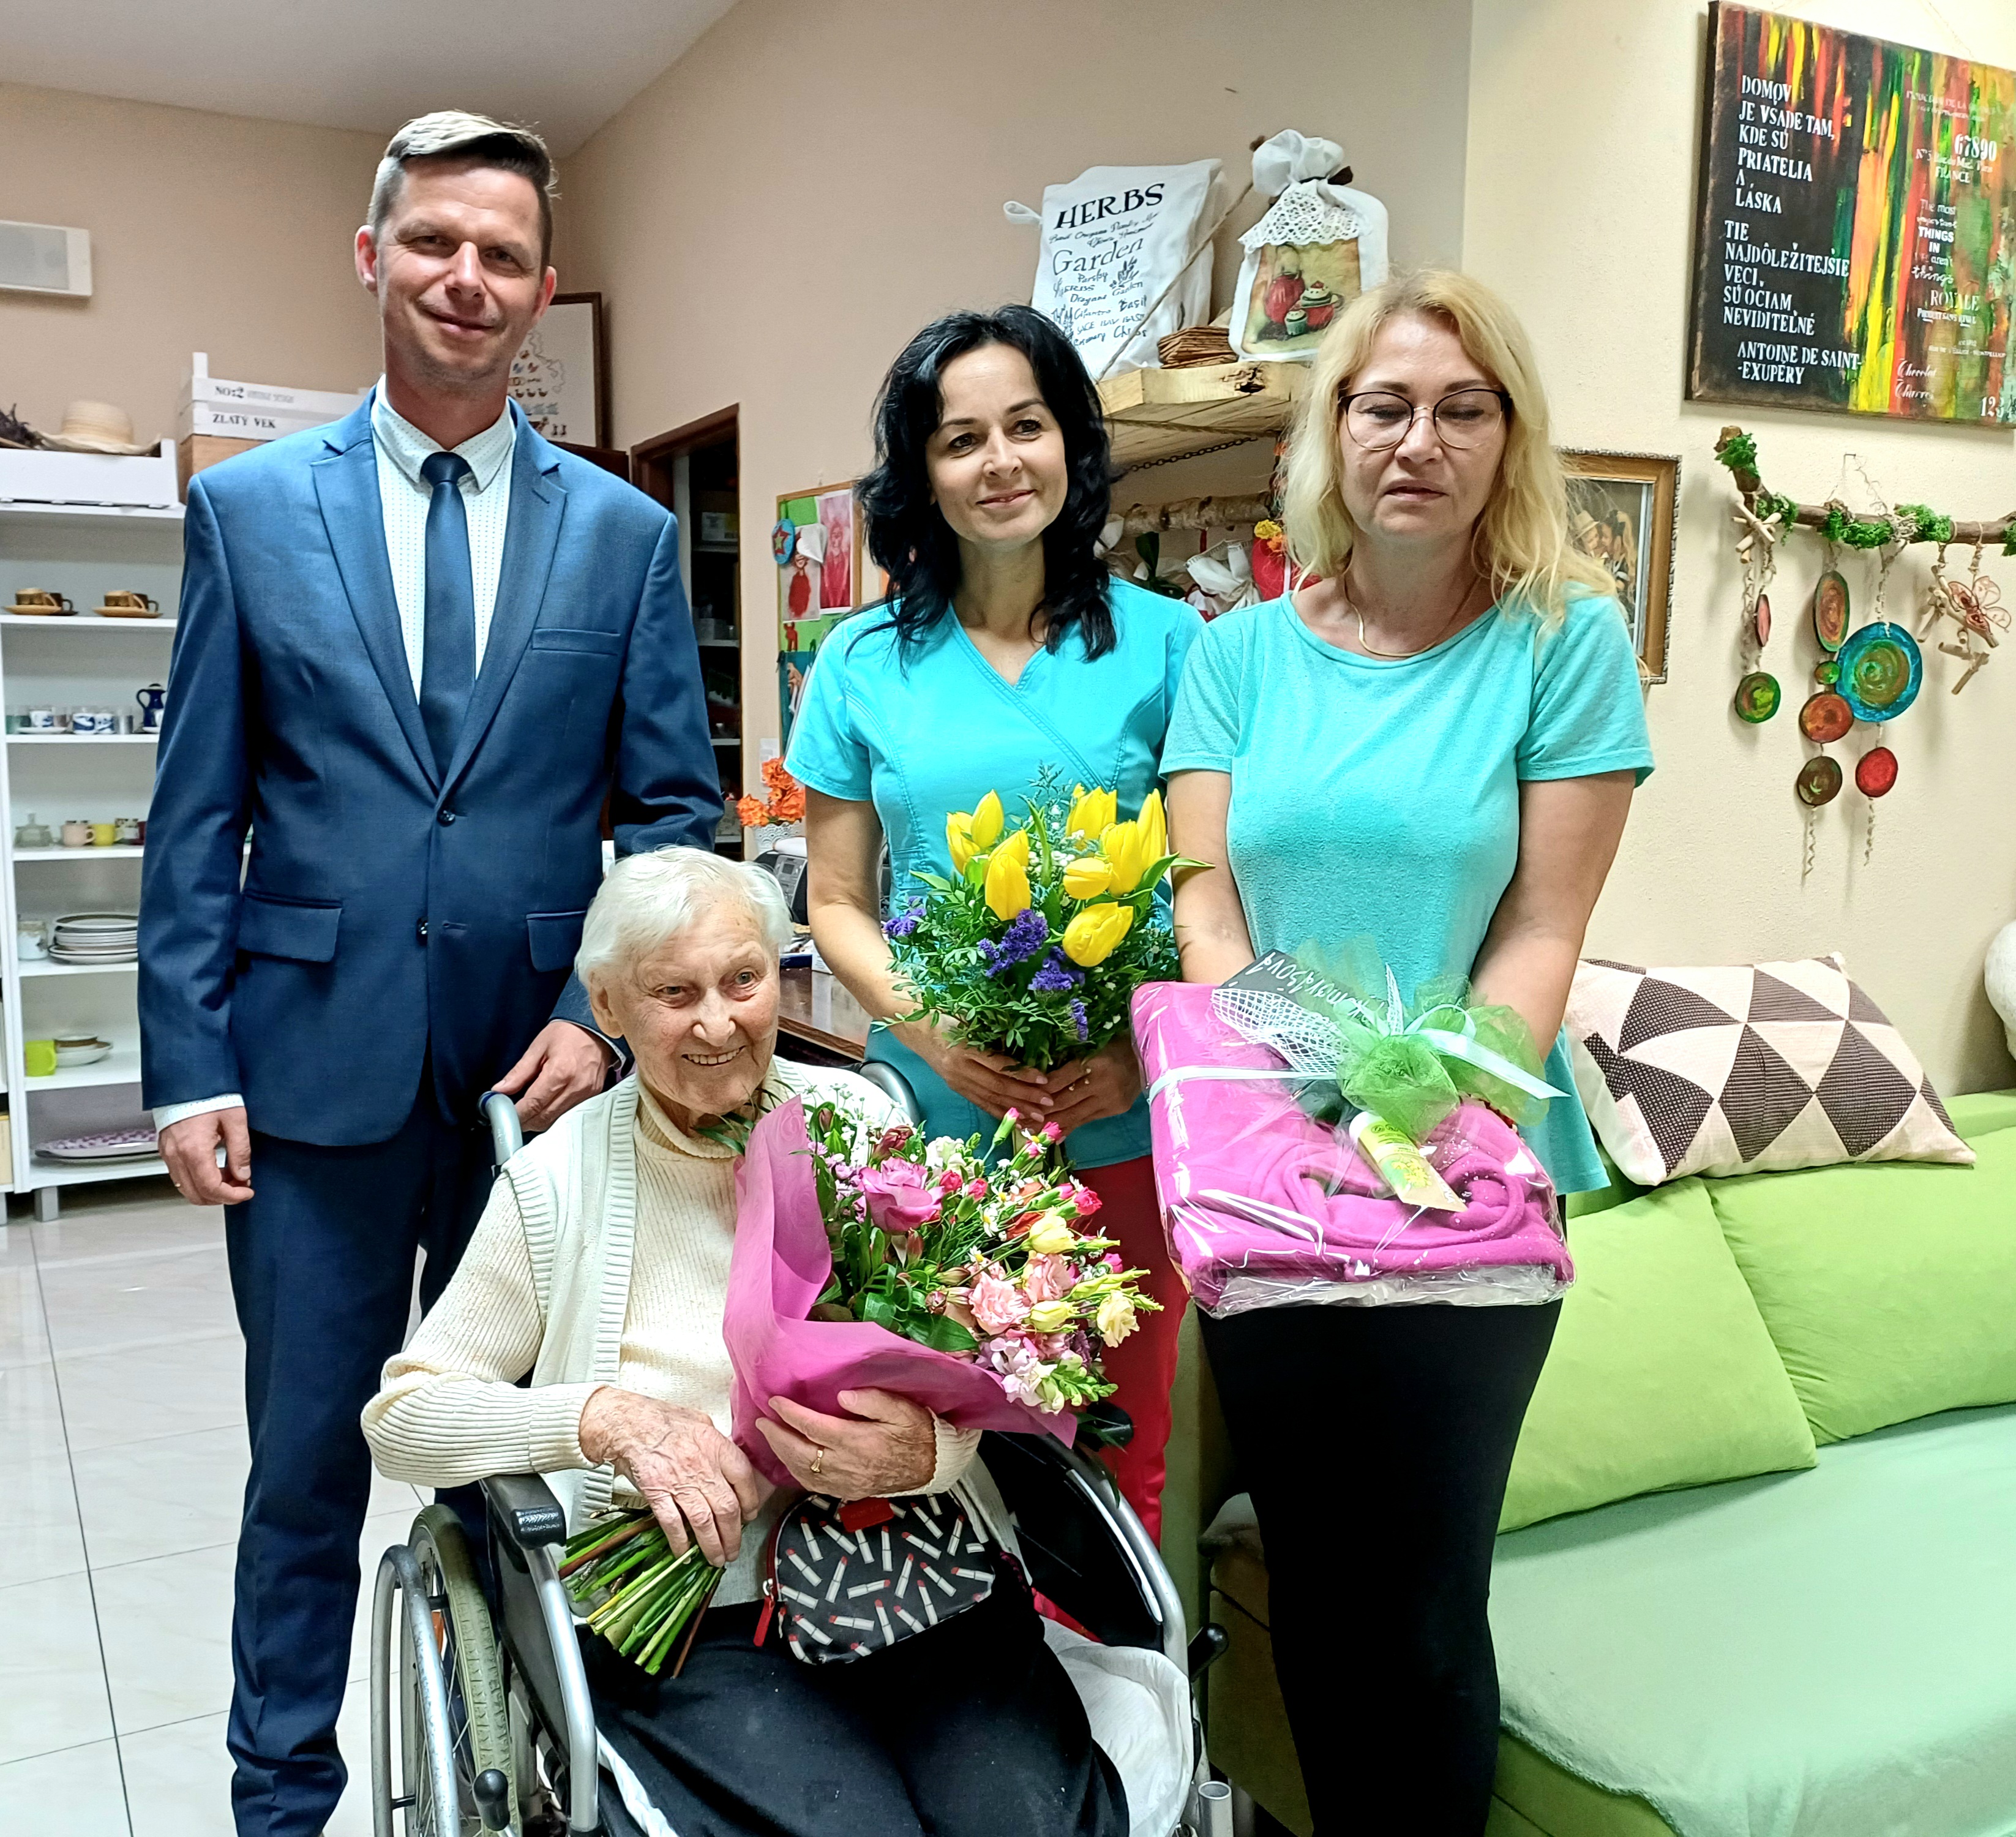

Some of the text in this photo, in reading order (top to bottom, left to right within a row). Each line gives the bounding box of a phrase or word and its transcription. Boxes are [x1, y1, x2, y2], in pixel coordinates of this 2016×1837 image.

[1742, 75, 1792, 102] DOMOV
[1739, 100, 1755, 121] JE
[1806, 115, 1835, 140] TAM,
[1739, 124, 1767, 146] KDE
[1955, 133, 1997, 162] 67890
[1737, 148, 1813, 181] PRIATELIA
[1936, 166, 1970, 183] FRANCE
[1736, 169, 1745, 186] A
[1053, 183, 1165, 230] HERBS
[1735, 183, 1782, 214] LÁSKA
[1725, 220, 1749, 241] TIE
[1918, 226, 1954, 242] THINGS
[1053, 238, 1144, 276] Garden
[1725, 242, 1850, 277] NAJDÔLEŽITEJŠIE
[1929, 241, 1941, 253] IN
[1745, 280, 1793, 311] OČIAM
[1930, 290, 1979, 311] ROYALE
[1737, 341, 1799, 364] ANTOINE
[1802, 347, 1819, 365] DE
[254, 417, 277, 429] VEK
